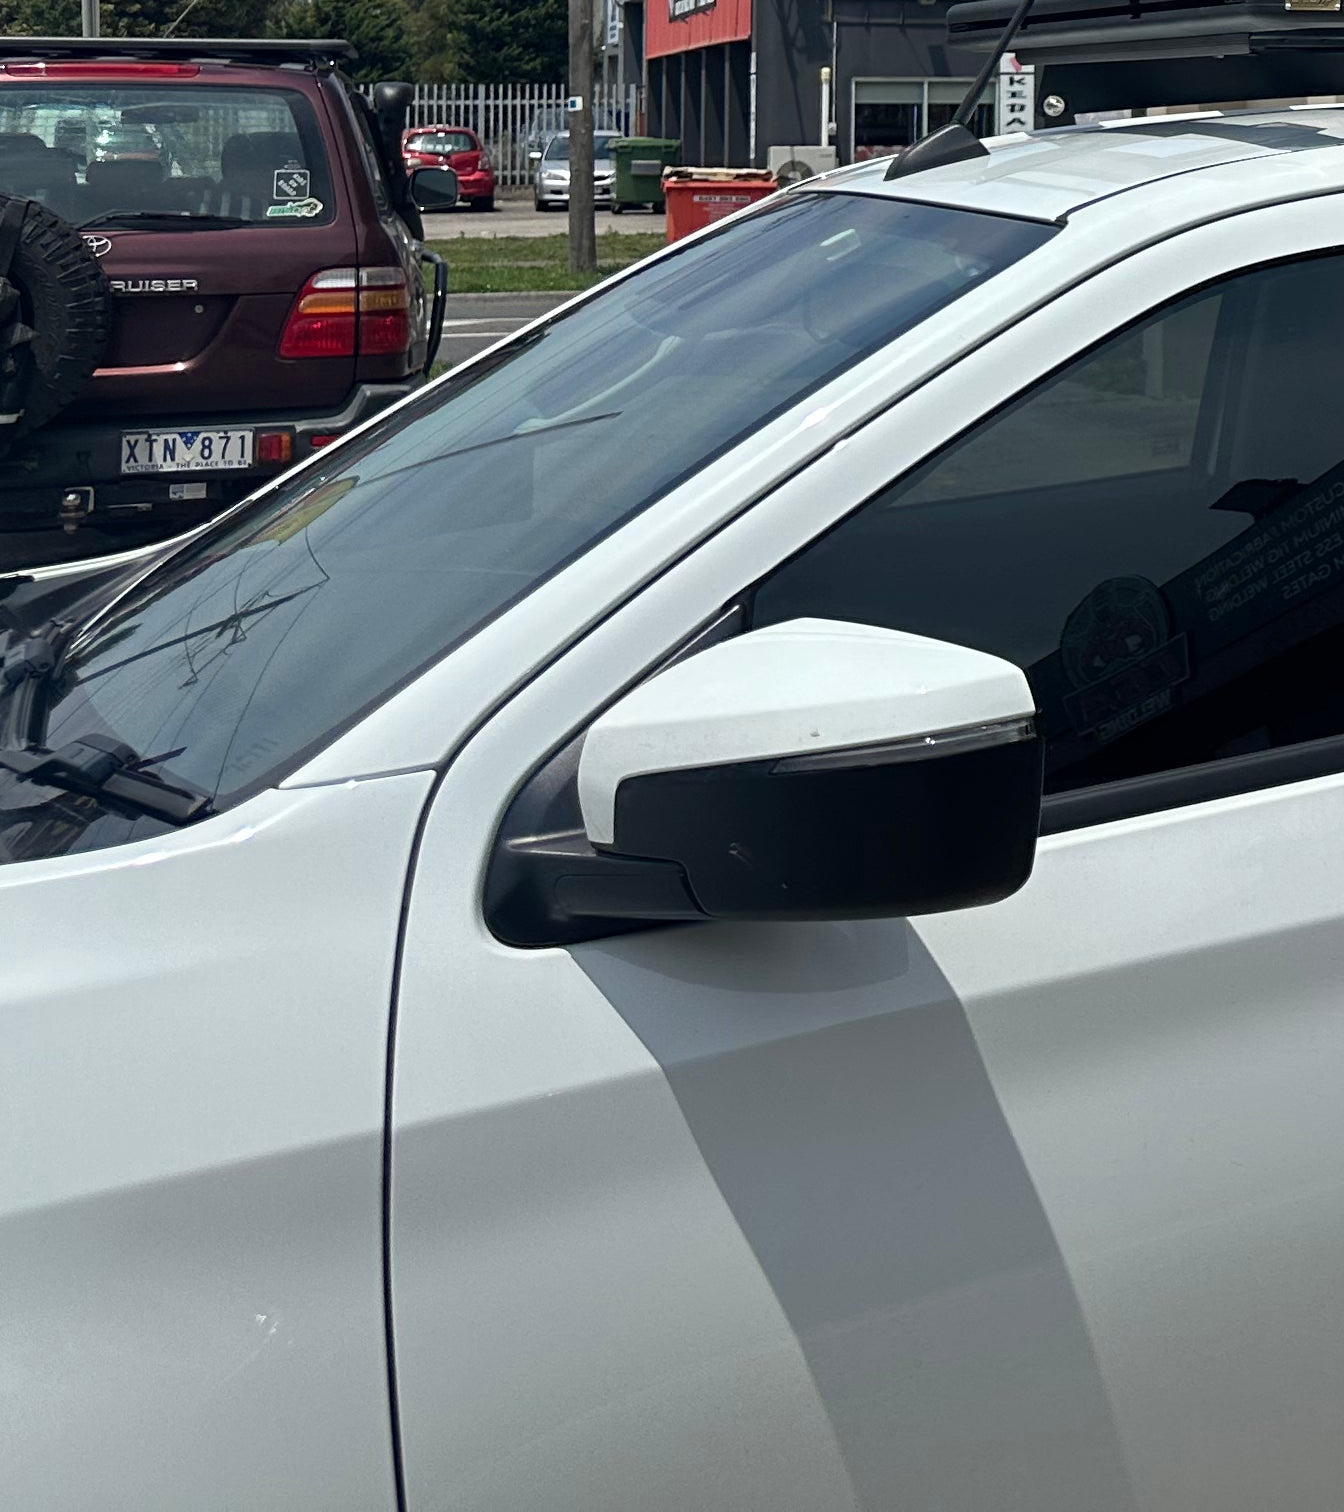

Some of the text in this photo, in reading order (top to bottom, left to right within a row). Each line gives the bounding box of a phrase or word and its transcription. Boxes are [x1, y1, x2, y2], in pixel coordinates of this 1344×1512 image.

[109, 279, 199, 292] RUISER
[125, 434, 246, 465] XTN 871
